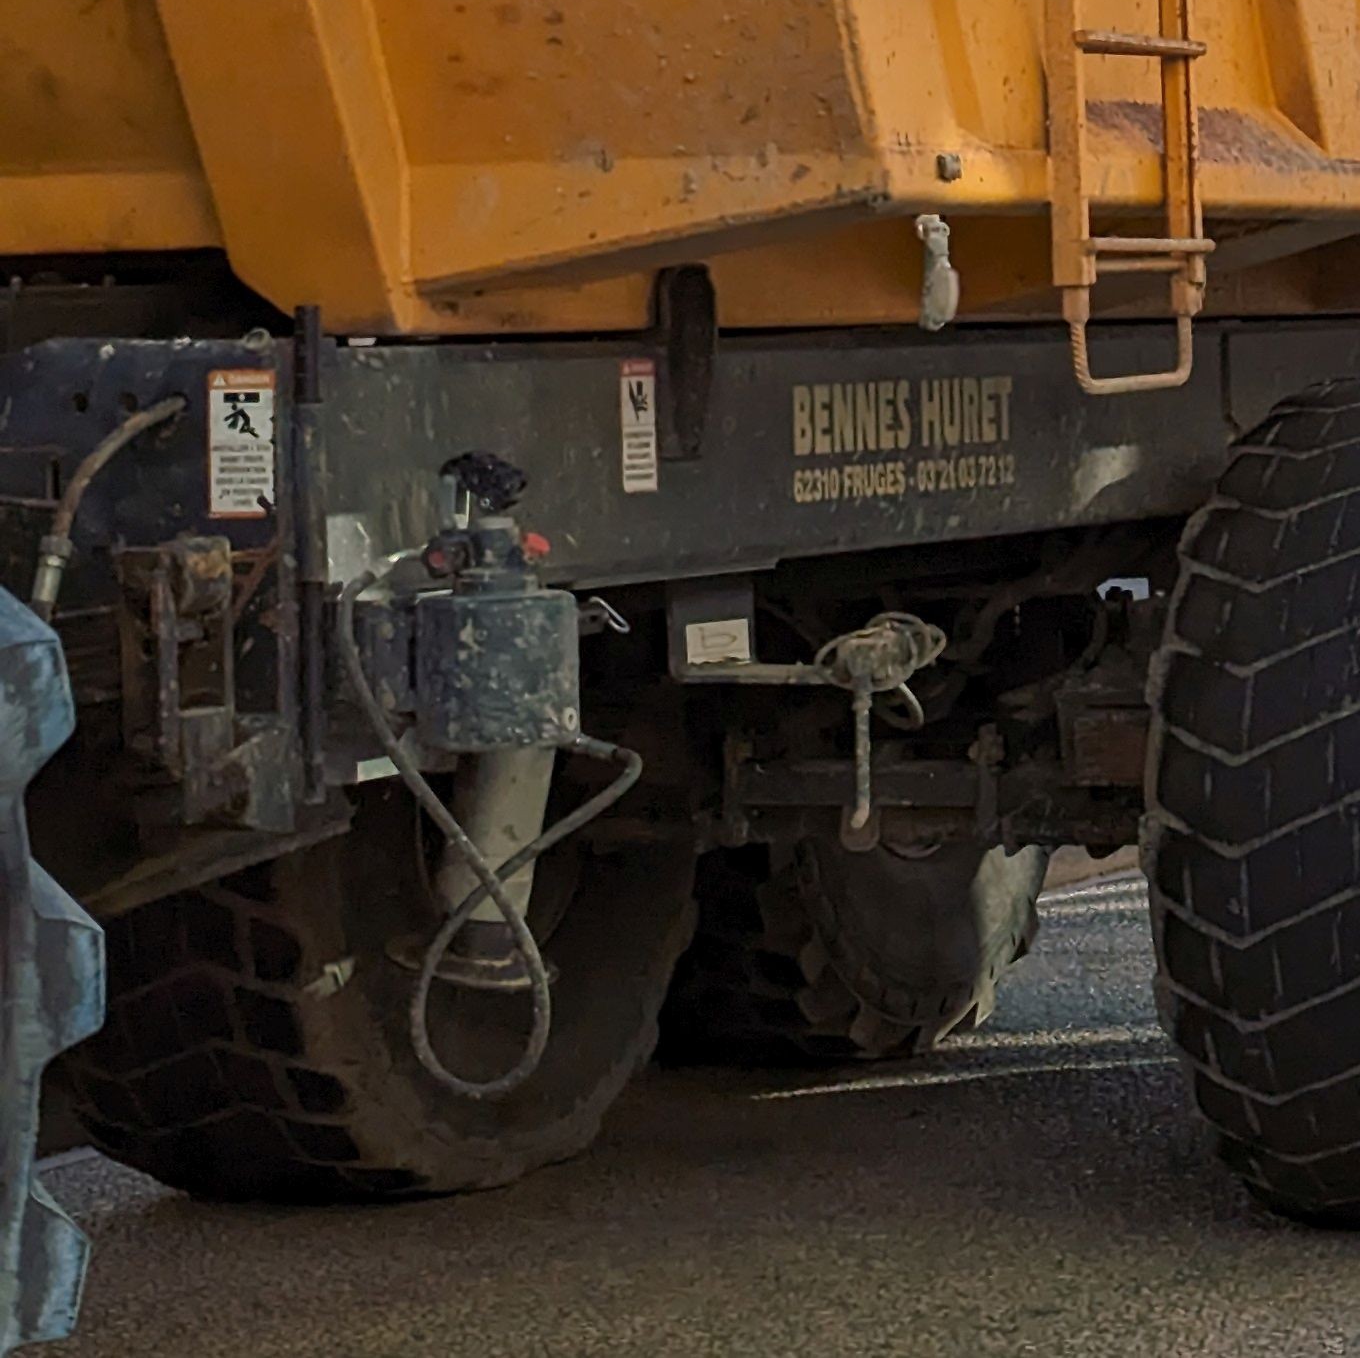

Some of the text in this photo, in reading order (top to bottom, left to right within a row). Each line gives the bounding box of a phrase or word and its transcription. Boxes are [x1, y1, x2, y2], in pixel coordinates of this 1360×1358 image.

[793, 376, 1012, 456] BENNES HURET
[793, 467, 840, 503] 62310
[843, 460, 905, 497] FRUGES
[917, 460, 934, 492] 03
[979, 455, 997, 485] 72
